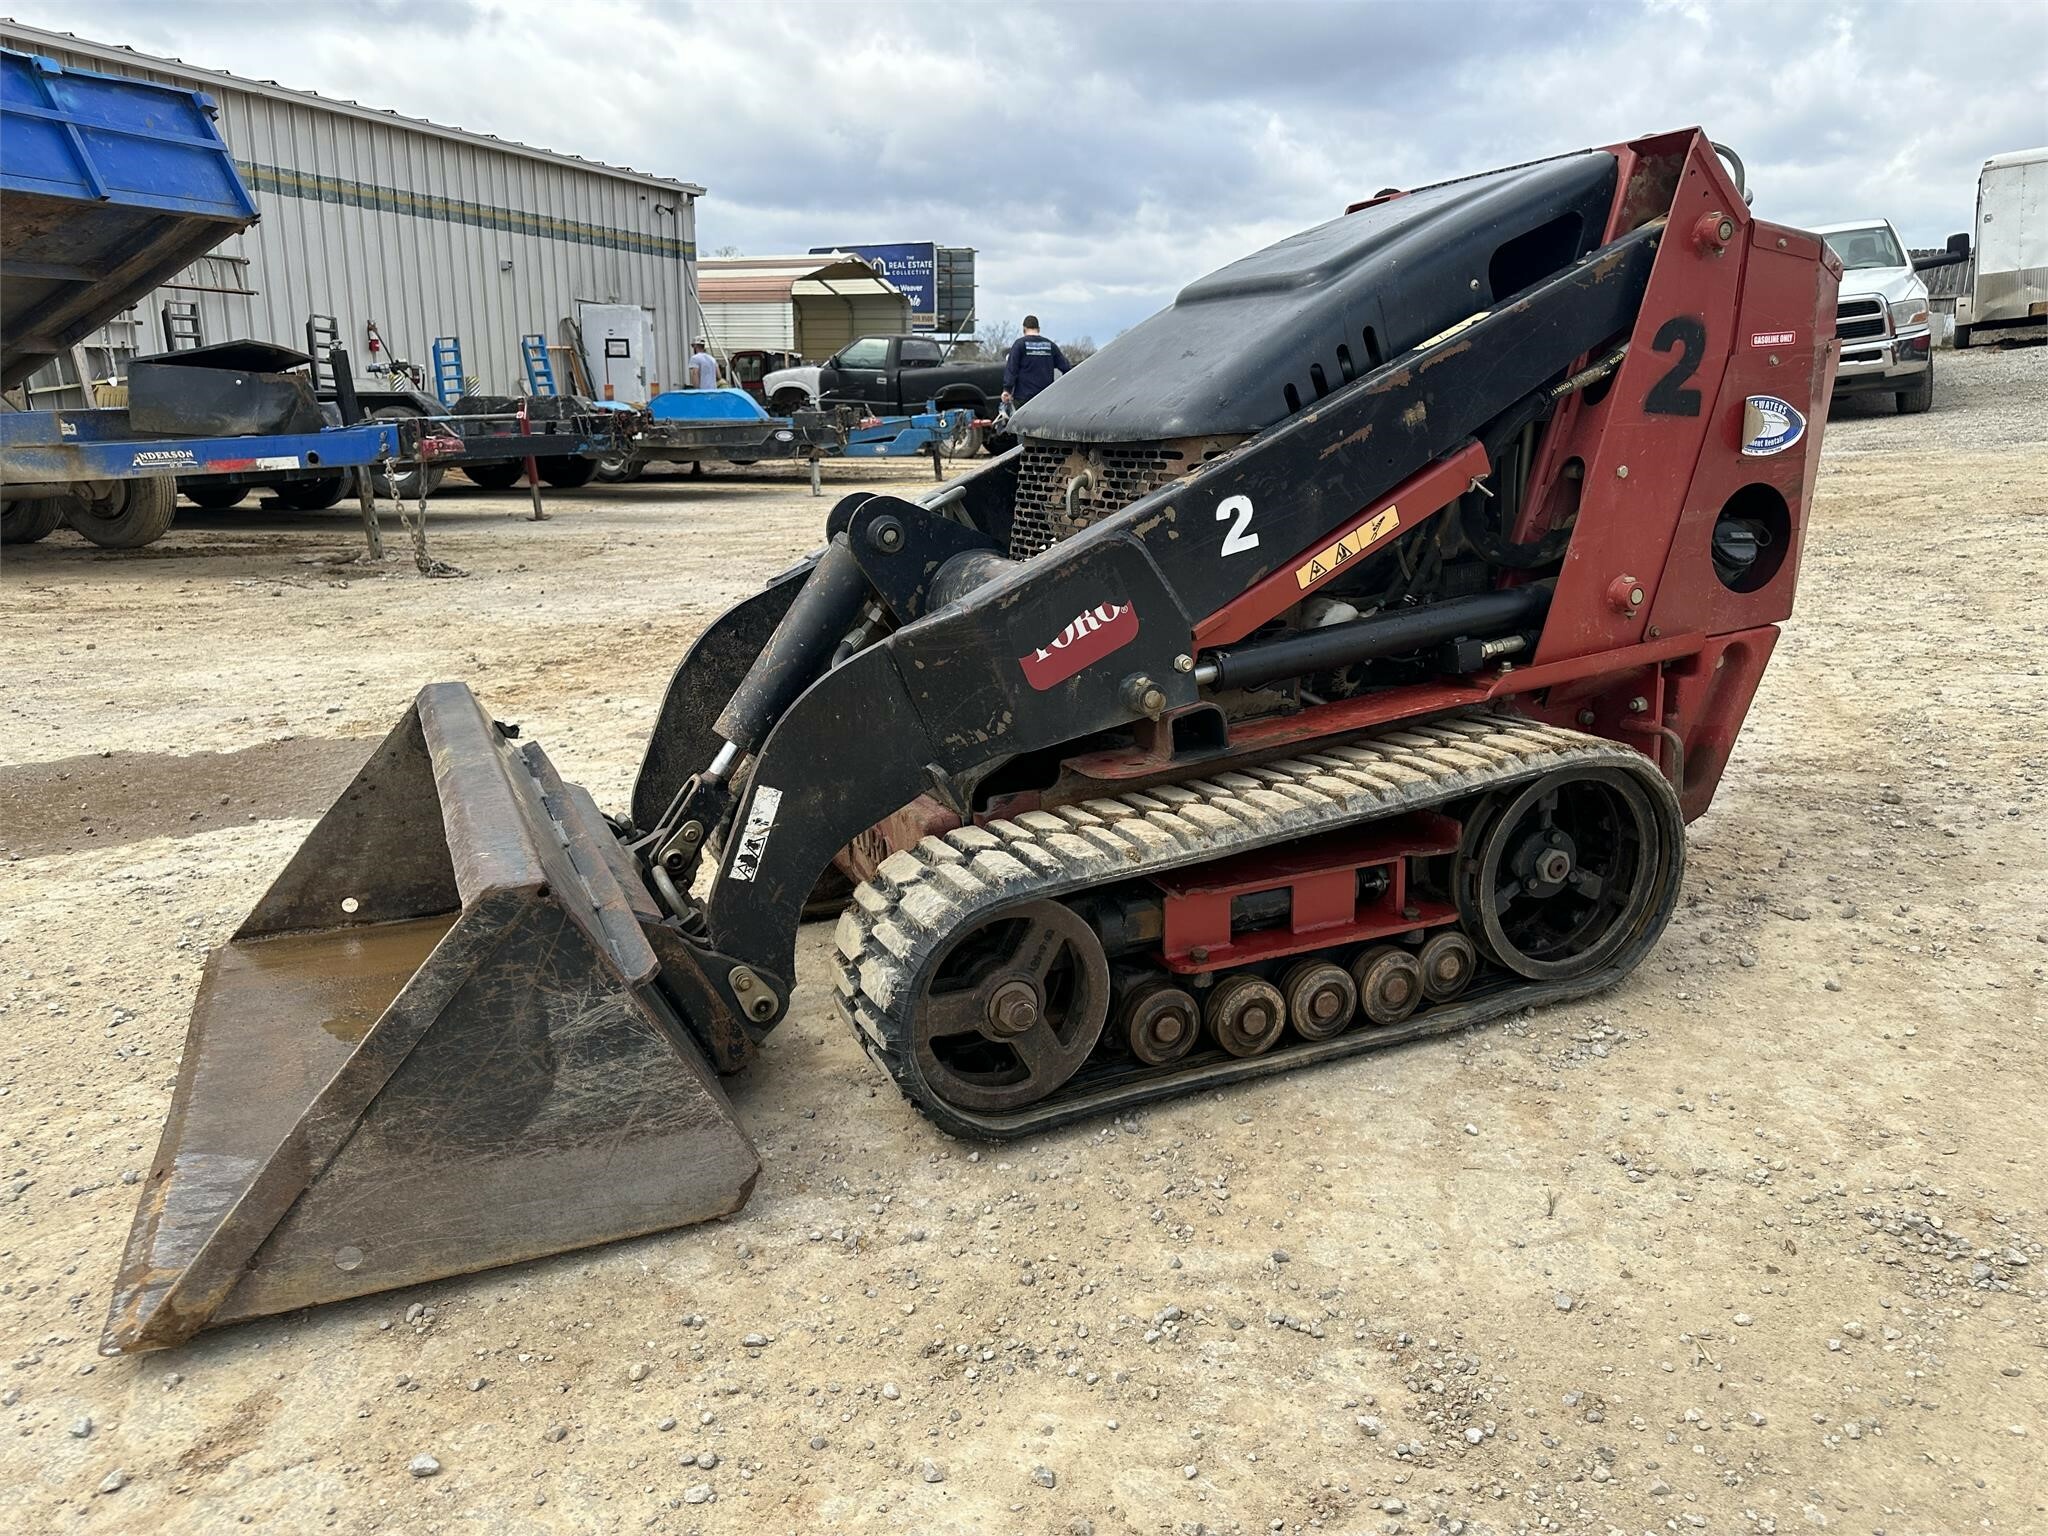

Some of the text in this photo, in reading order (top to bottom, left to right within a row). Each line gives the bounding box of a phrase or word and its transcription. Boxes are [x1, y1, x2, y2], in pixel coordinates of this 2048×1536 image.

[907, 261, 933, 269] ESTATE
[1754, 333, 1794, 345] GASOLINE ONLY
[1643, 317, 1706, 416] 2
[1751, 400, 1788, 415] EWATERS
[132, 450, 194, 466] ANDERSON
[1215, 494, 1260, 557] 2
